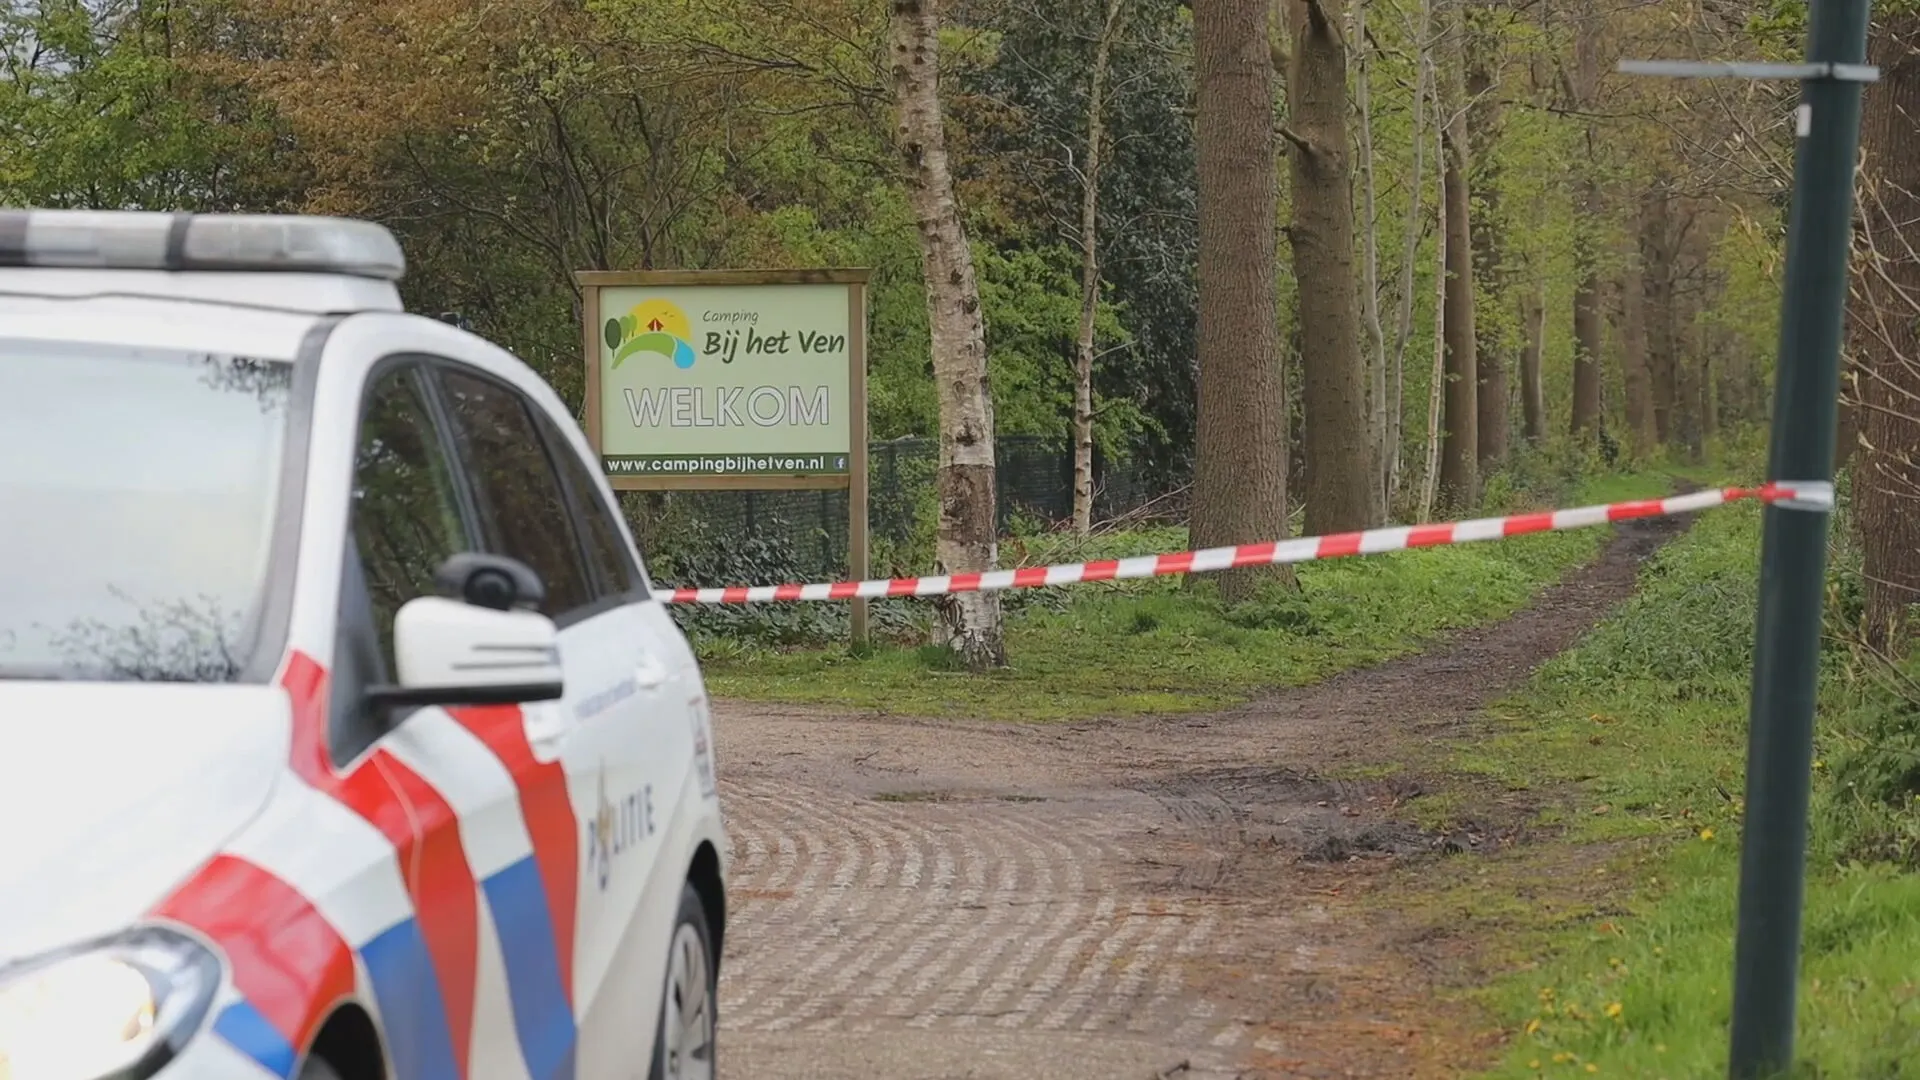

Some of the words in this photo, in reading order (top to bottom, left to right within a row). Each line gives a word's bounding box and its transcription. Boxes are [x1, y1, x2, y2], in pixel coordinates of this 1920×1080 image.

[702, 309, 759, 326] Camping
[703, 329, 740, 364] Bij
[745, 326, 791, 355] het
[797, 329, 845, 355] Ven
[623, 385, 830, 428] WELKOM
[607, 455, 825, 474] www.campingbijhetven.nl
